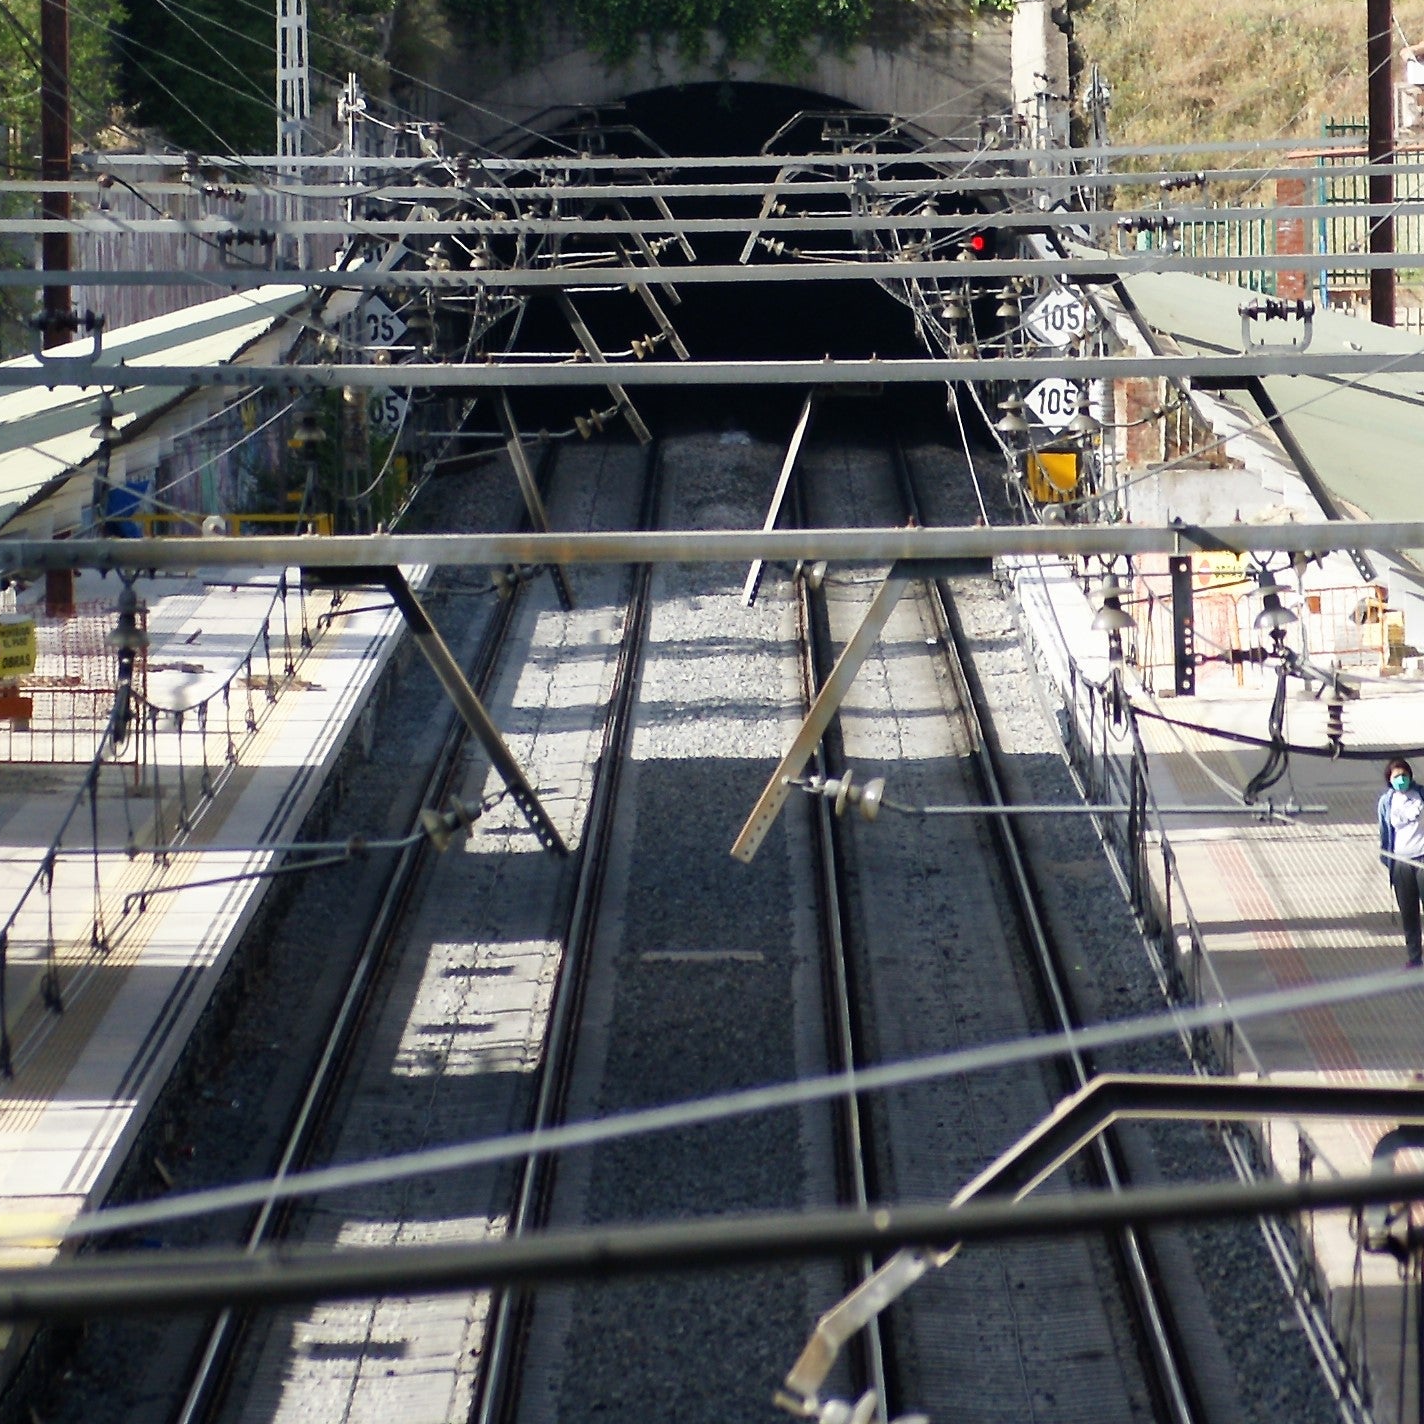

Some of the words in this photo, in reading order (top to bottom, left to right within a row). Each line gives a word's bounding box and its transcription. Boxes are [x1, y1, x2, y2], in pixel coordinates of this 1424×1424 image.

[365, 313, 394, 342] 05
[1041, 303, 1080, 331] 105
[369, 395, 400, 424] 05
[1038, 388, 1076, 416] 105
